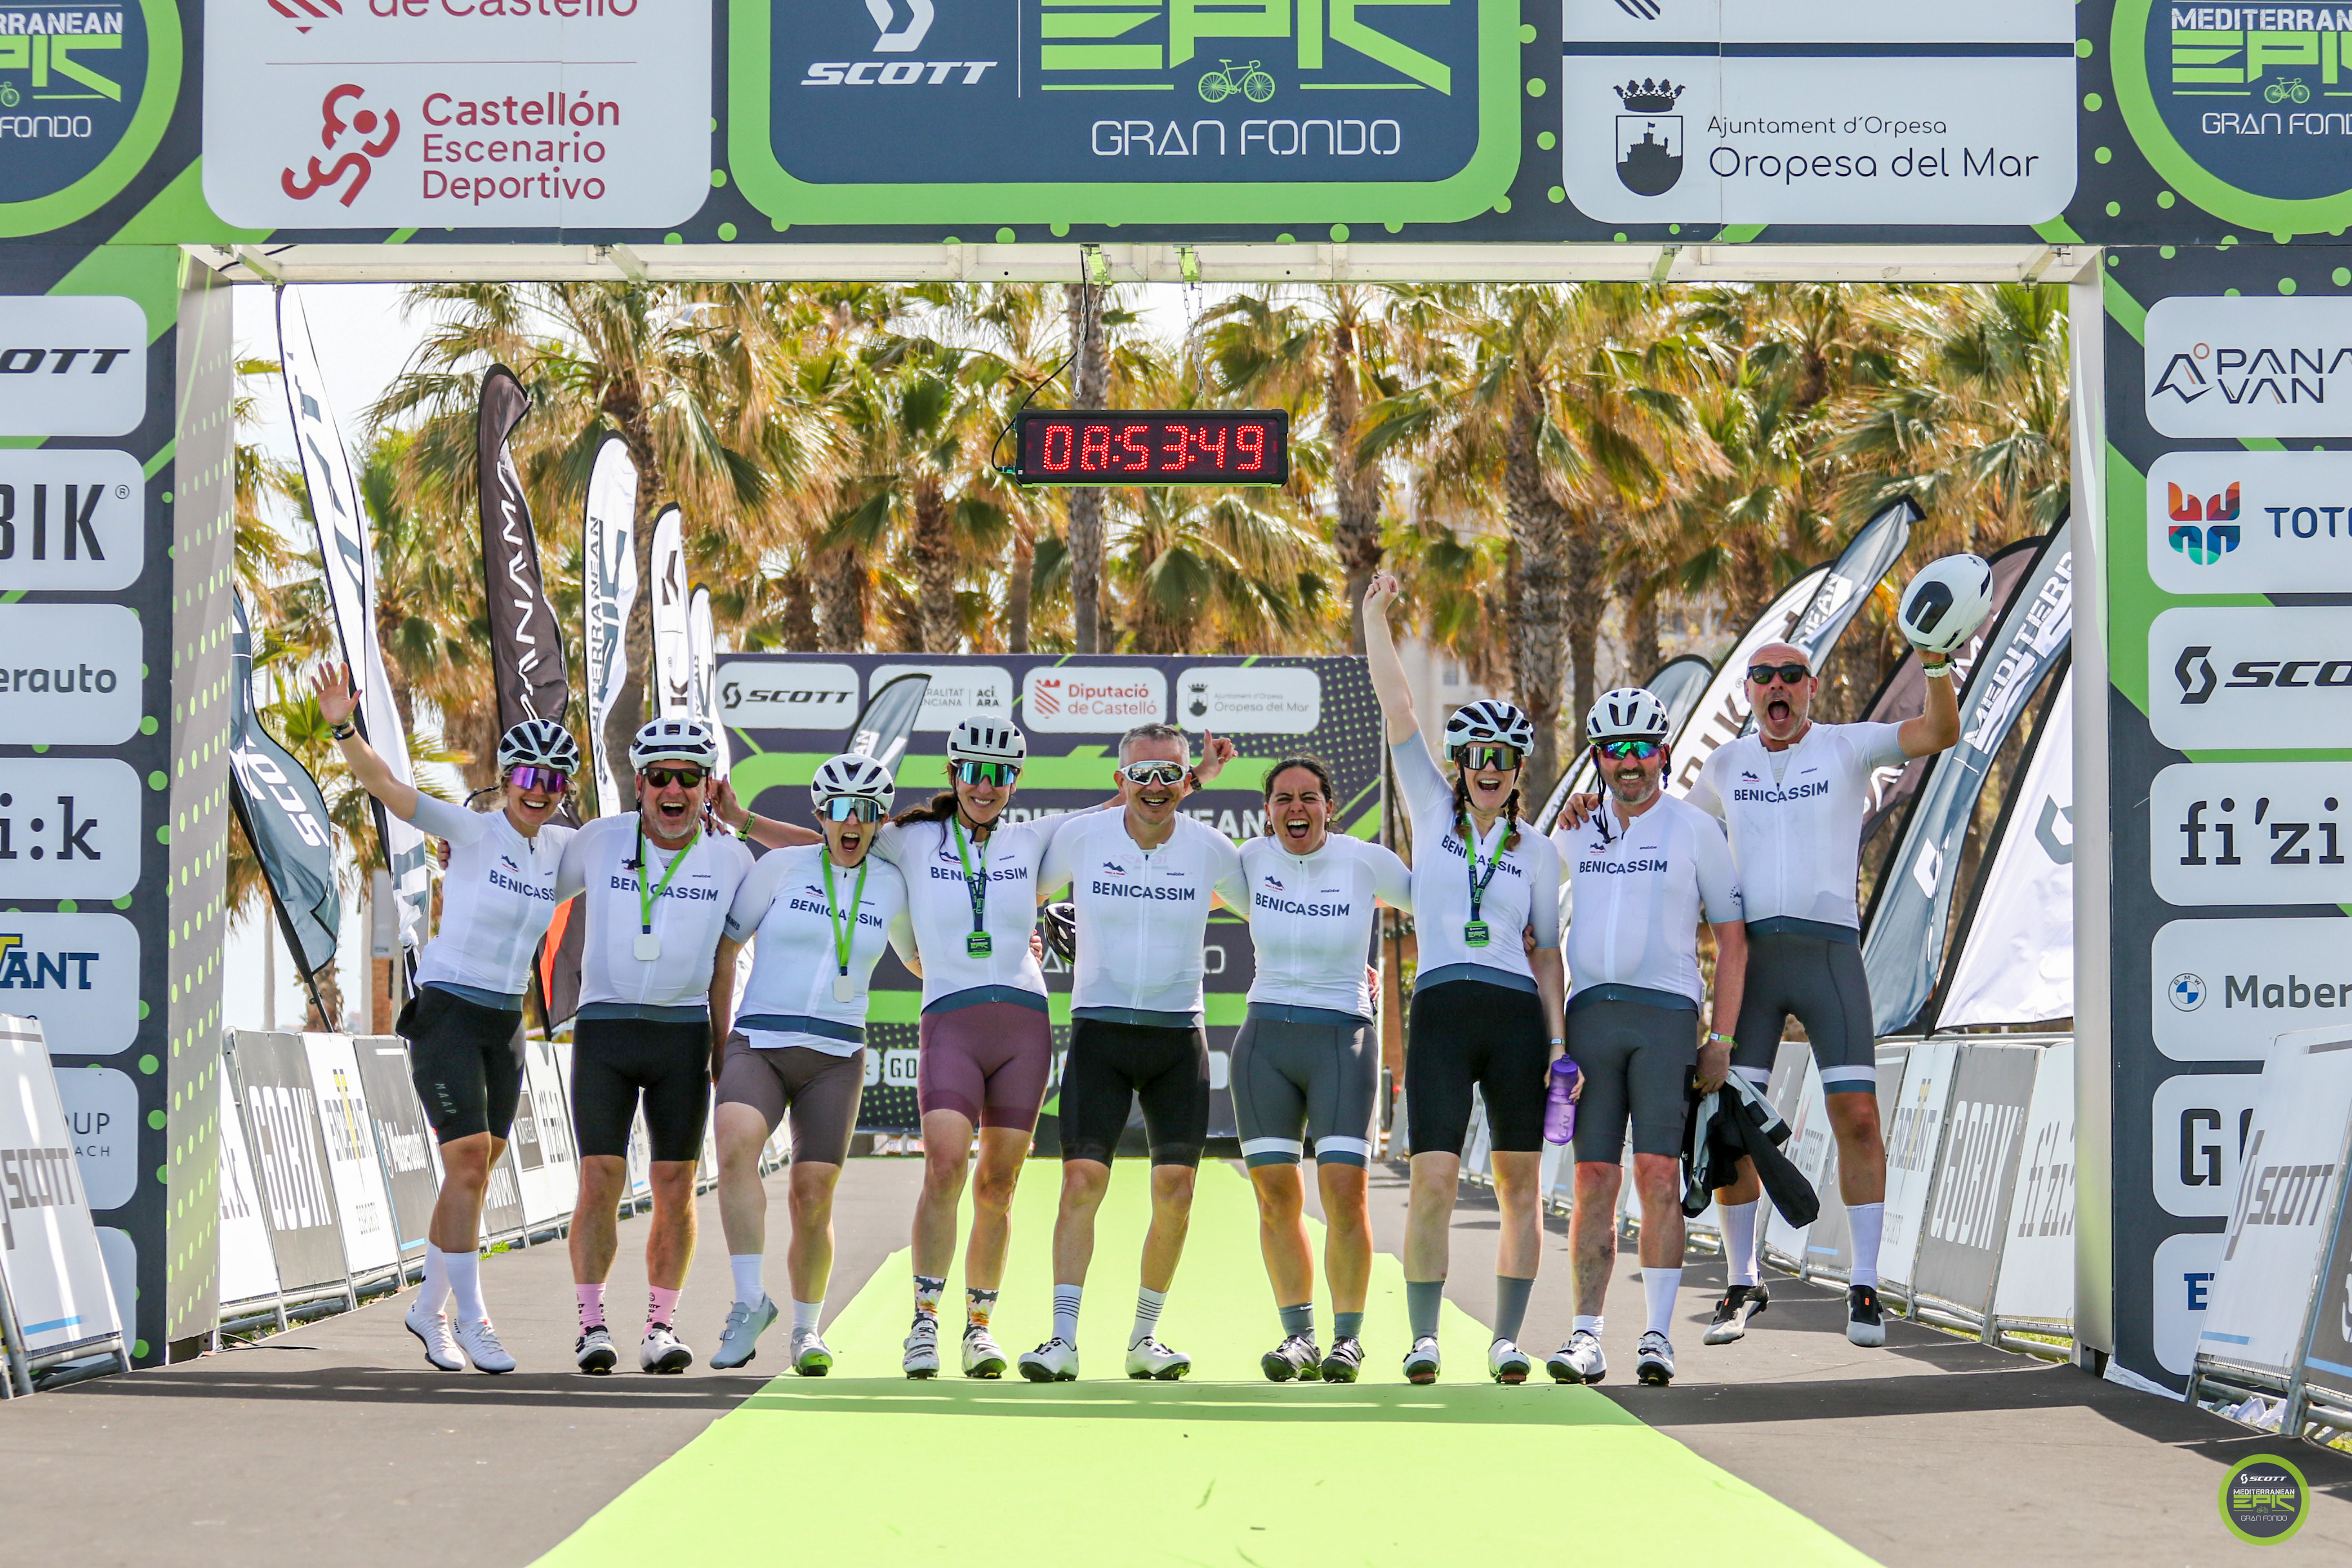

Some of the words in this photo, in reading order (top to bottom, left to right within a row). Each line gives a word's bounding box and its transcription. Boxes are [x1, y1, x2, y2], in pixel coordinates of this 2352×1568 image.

[2172, 30, 2352, 84] EPI
[800, 61, 998, 86] SCOTT
[422, 90, 620, 126] Castellón
[1708, 116, 1836, 138] Ajuntament
[2202, 112, 2281, 135] GRAN
[424, 131, 606, 162] Escenario
[1092, 119, 1225, 157] GRAN
[1241, 119, 1401, 157] FONDO
[1709, 147, 1877, 184] Oropesa
[1891, 146, 1949, 177] del
[1964, 147, 2039, 177] Mar
[424, 166, 605, 206] Deportivo
[0, 349, 130, 374] OTT
[2217, 378, 2324, 404] VAN
[2264, 507, 2352, 538] TOT
[745, 690, 854, 704] SCOTT
[922, 698, 962, 707] NCIANA
[926, 688, 965, 697] RALITAT
[1068, 683, 1149, 701] Diputació
[1068, 700, 1088, 715] de
[1092, 700, 1157, 715] Castelló
[1214, 701, 1263, 714] Oropesa
[1266, 701, 1284, 712] del
[1287, 702, 1309, 712] Mar
[1734, 779, 1829, 803] BENICASSIM
[1441, 834, 1522, 878] BENIASSIM
[1579, 859, 1668, 875] BENICASSIM
[489, 868, 555, 902] BENICASS
[1092, 881, 1195, 901] BENICASSIM
[1255, 892, 1350, 917] BENICASSIM
[63, 1113, 110, 1135] UP
[2247, 1164, 2335, 1226] SCOTT
